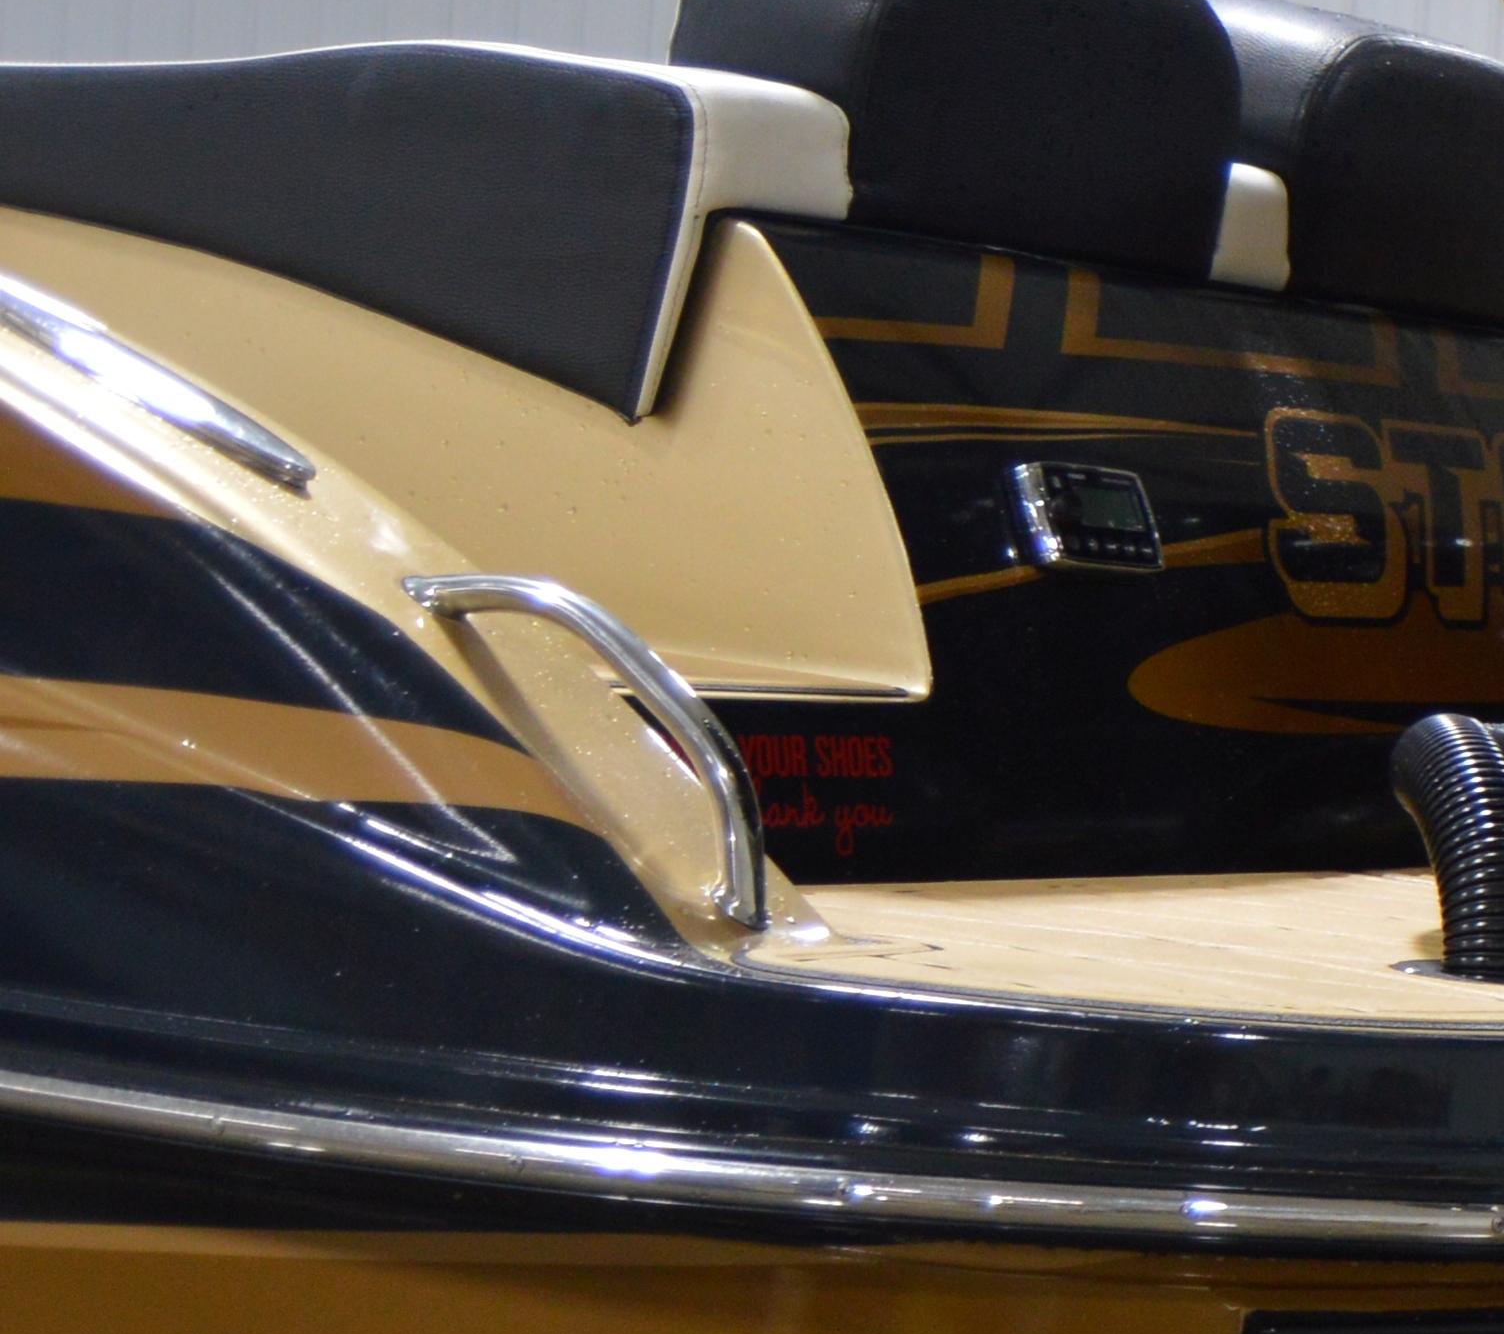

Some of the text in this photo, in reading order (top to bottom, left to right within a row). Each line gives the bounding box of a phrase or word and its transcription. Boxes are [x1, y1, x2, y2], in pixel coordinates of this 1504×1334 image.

[737, 733, 895, 779] YOUR SHOES
[833, 801, 896, 857] you
